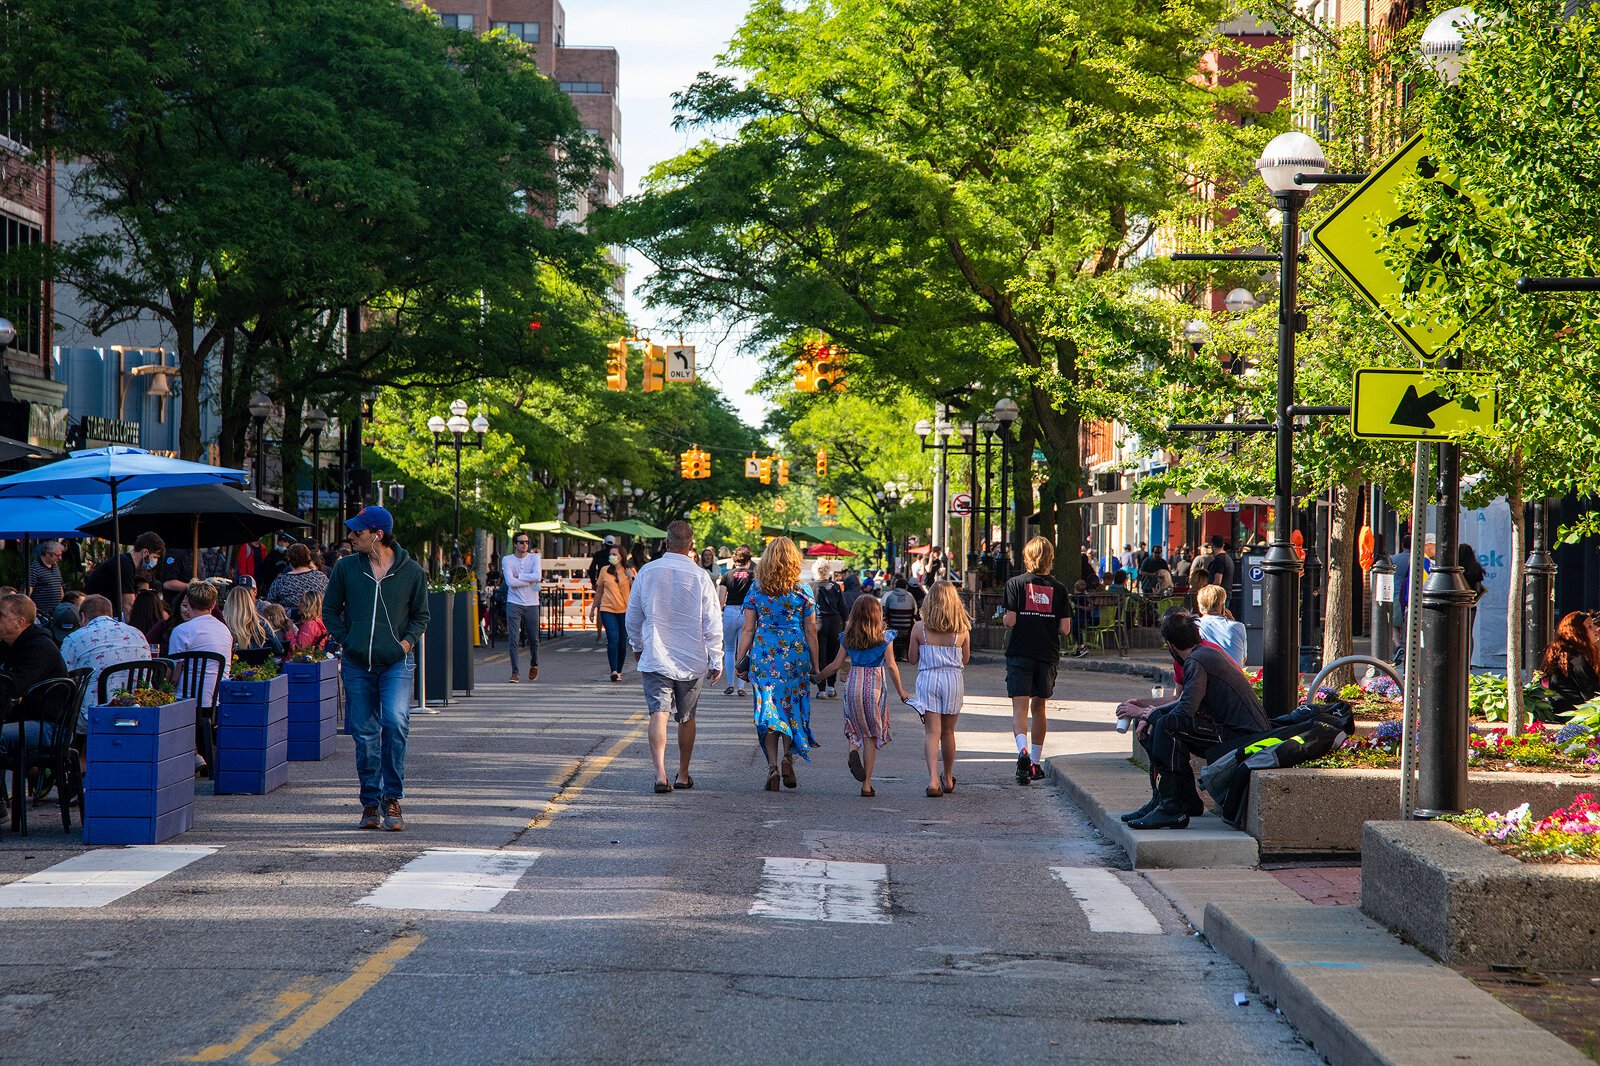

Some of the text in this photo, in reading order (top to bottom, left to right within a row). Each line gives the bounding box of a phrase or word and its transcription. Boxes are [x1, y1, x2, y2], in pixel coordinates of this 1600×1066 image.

[670, 370, 690, 378] ONLY
[87, 415, 119, 442] STARBUCKS
[119, 419, 139, 444] COFFEE
[1477, 549, 1504, 567] ek
[1252, 567, 1262, 579] P
